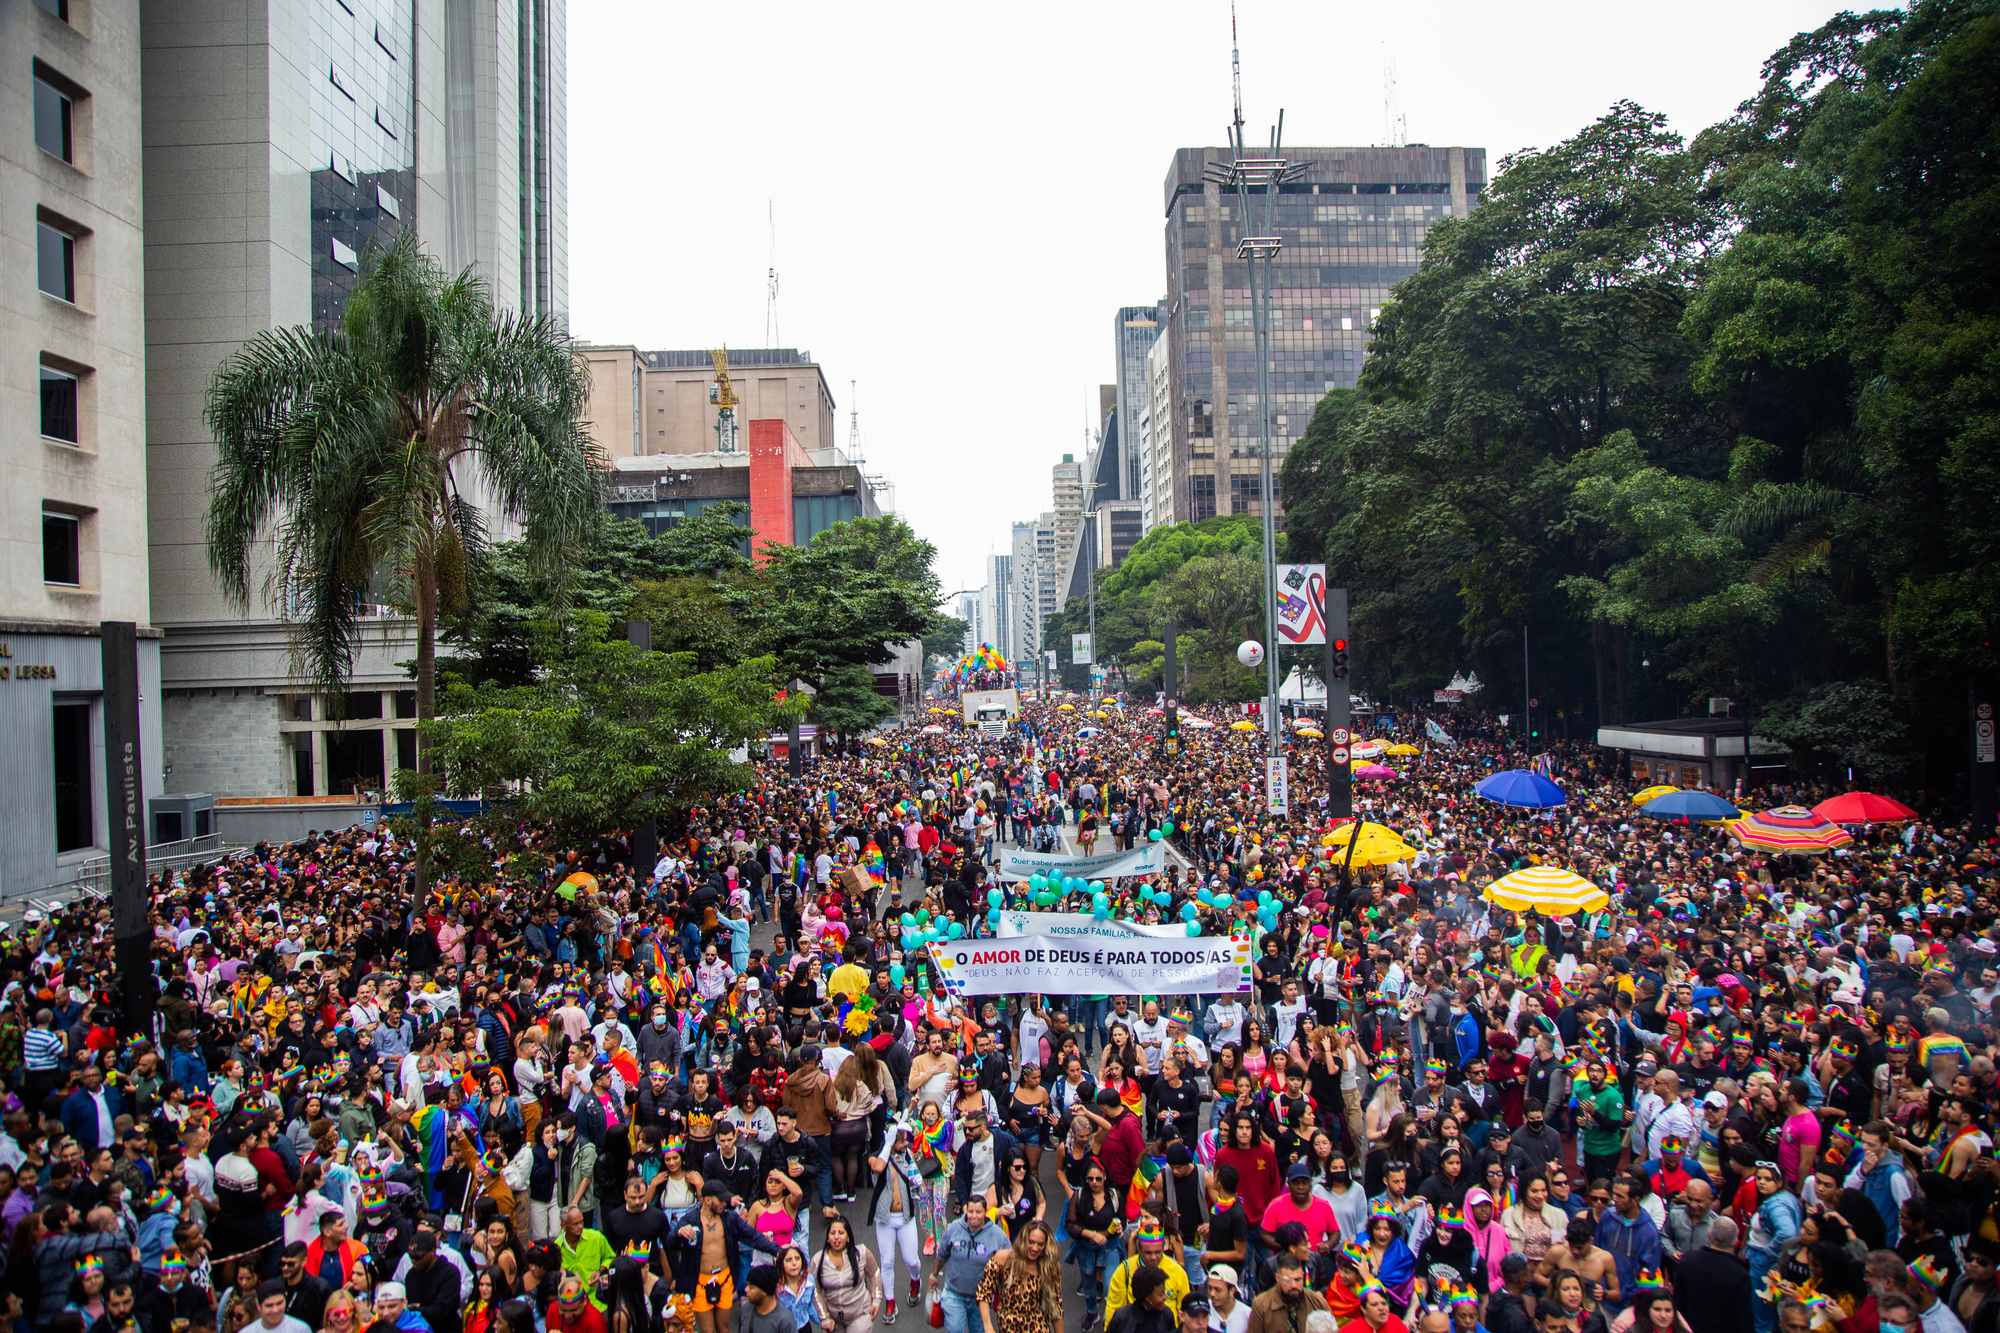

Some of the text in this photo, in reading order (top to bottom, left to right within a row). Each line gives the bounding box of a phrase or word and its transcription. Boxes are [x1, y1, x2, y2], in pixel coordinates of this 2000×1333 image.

[16, 664, 56, 680] LESSA
[1335, 731, 1346, 740] 50
[124, 742, 138, 863] Av. Paulista
[1011, 857, 1029, 865] Quer
[1031, 859, 1052, 867] saber
[1050, 926, 1089, 936] NOSSAS
[956, 949, 1232, 966] O AMOR DE DEUS É PARA TODOS/AS
[1005, 966, 1031, 976] NÃO
[1037, 967, 1060, 977] FAZ
[1131, 968, 1145, 978] DE
